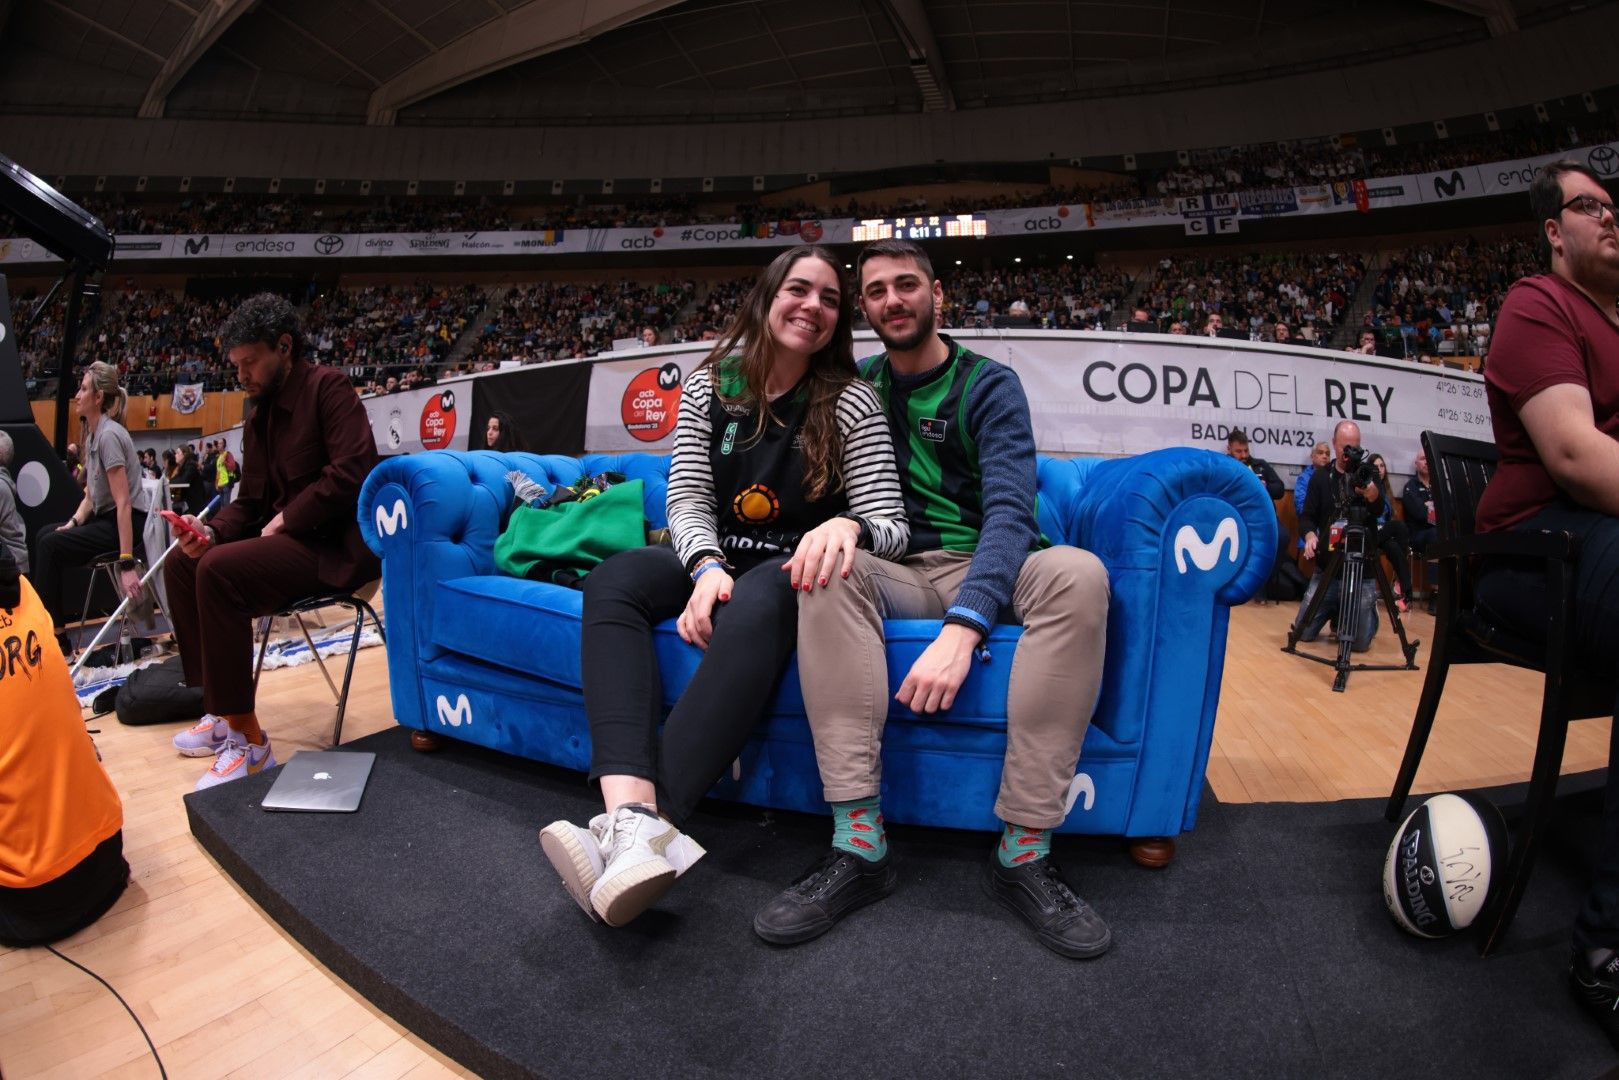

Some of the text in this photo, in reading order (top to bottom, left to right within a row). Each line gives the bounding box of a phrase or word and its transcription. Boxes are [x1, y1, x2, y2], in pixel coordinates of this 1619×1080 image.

[1024, 216, 1062, 231] acb
[235, 238, 295, 252] endesa
[365, 239, 393, 247] divina
[409, 238, 450, 249] SPALDING
[621, 237, 655, 249] acb
[639, 389, 655, 398] acb
[1082, 360, 1394, 424] COPA DEL REY
[632, 398, 663, 410] Copa
[646, 410, 667, 422] Rey
[425, 418, 444, 427] Copa
[433, 427, 447, 437] Rey
[1400, 829, 1438, 927] SPALDING
